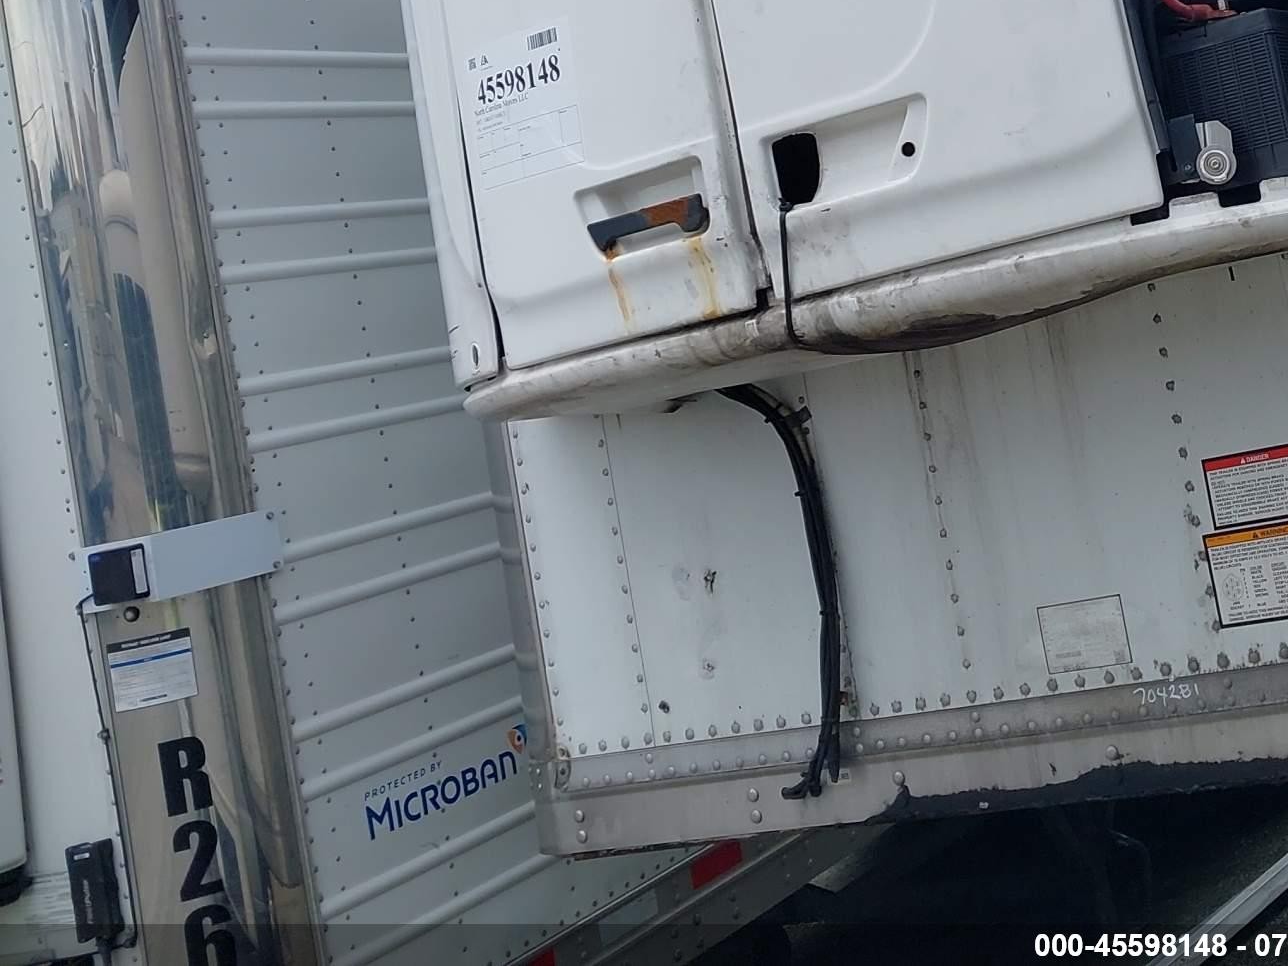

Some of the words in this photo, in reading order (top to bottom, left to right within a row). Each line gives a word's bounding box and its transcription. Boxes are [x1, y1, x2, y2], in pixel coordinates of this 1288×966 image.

[477, 54, 561, 105] 45598148
[364, 767, 426, 802] PROTECTED
[430, 760, 442, 773] BY
